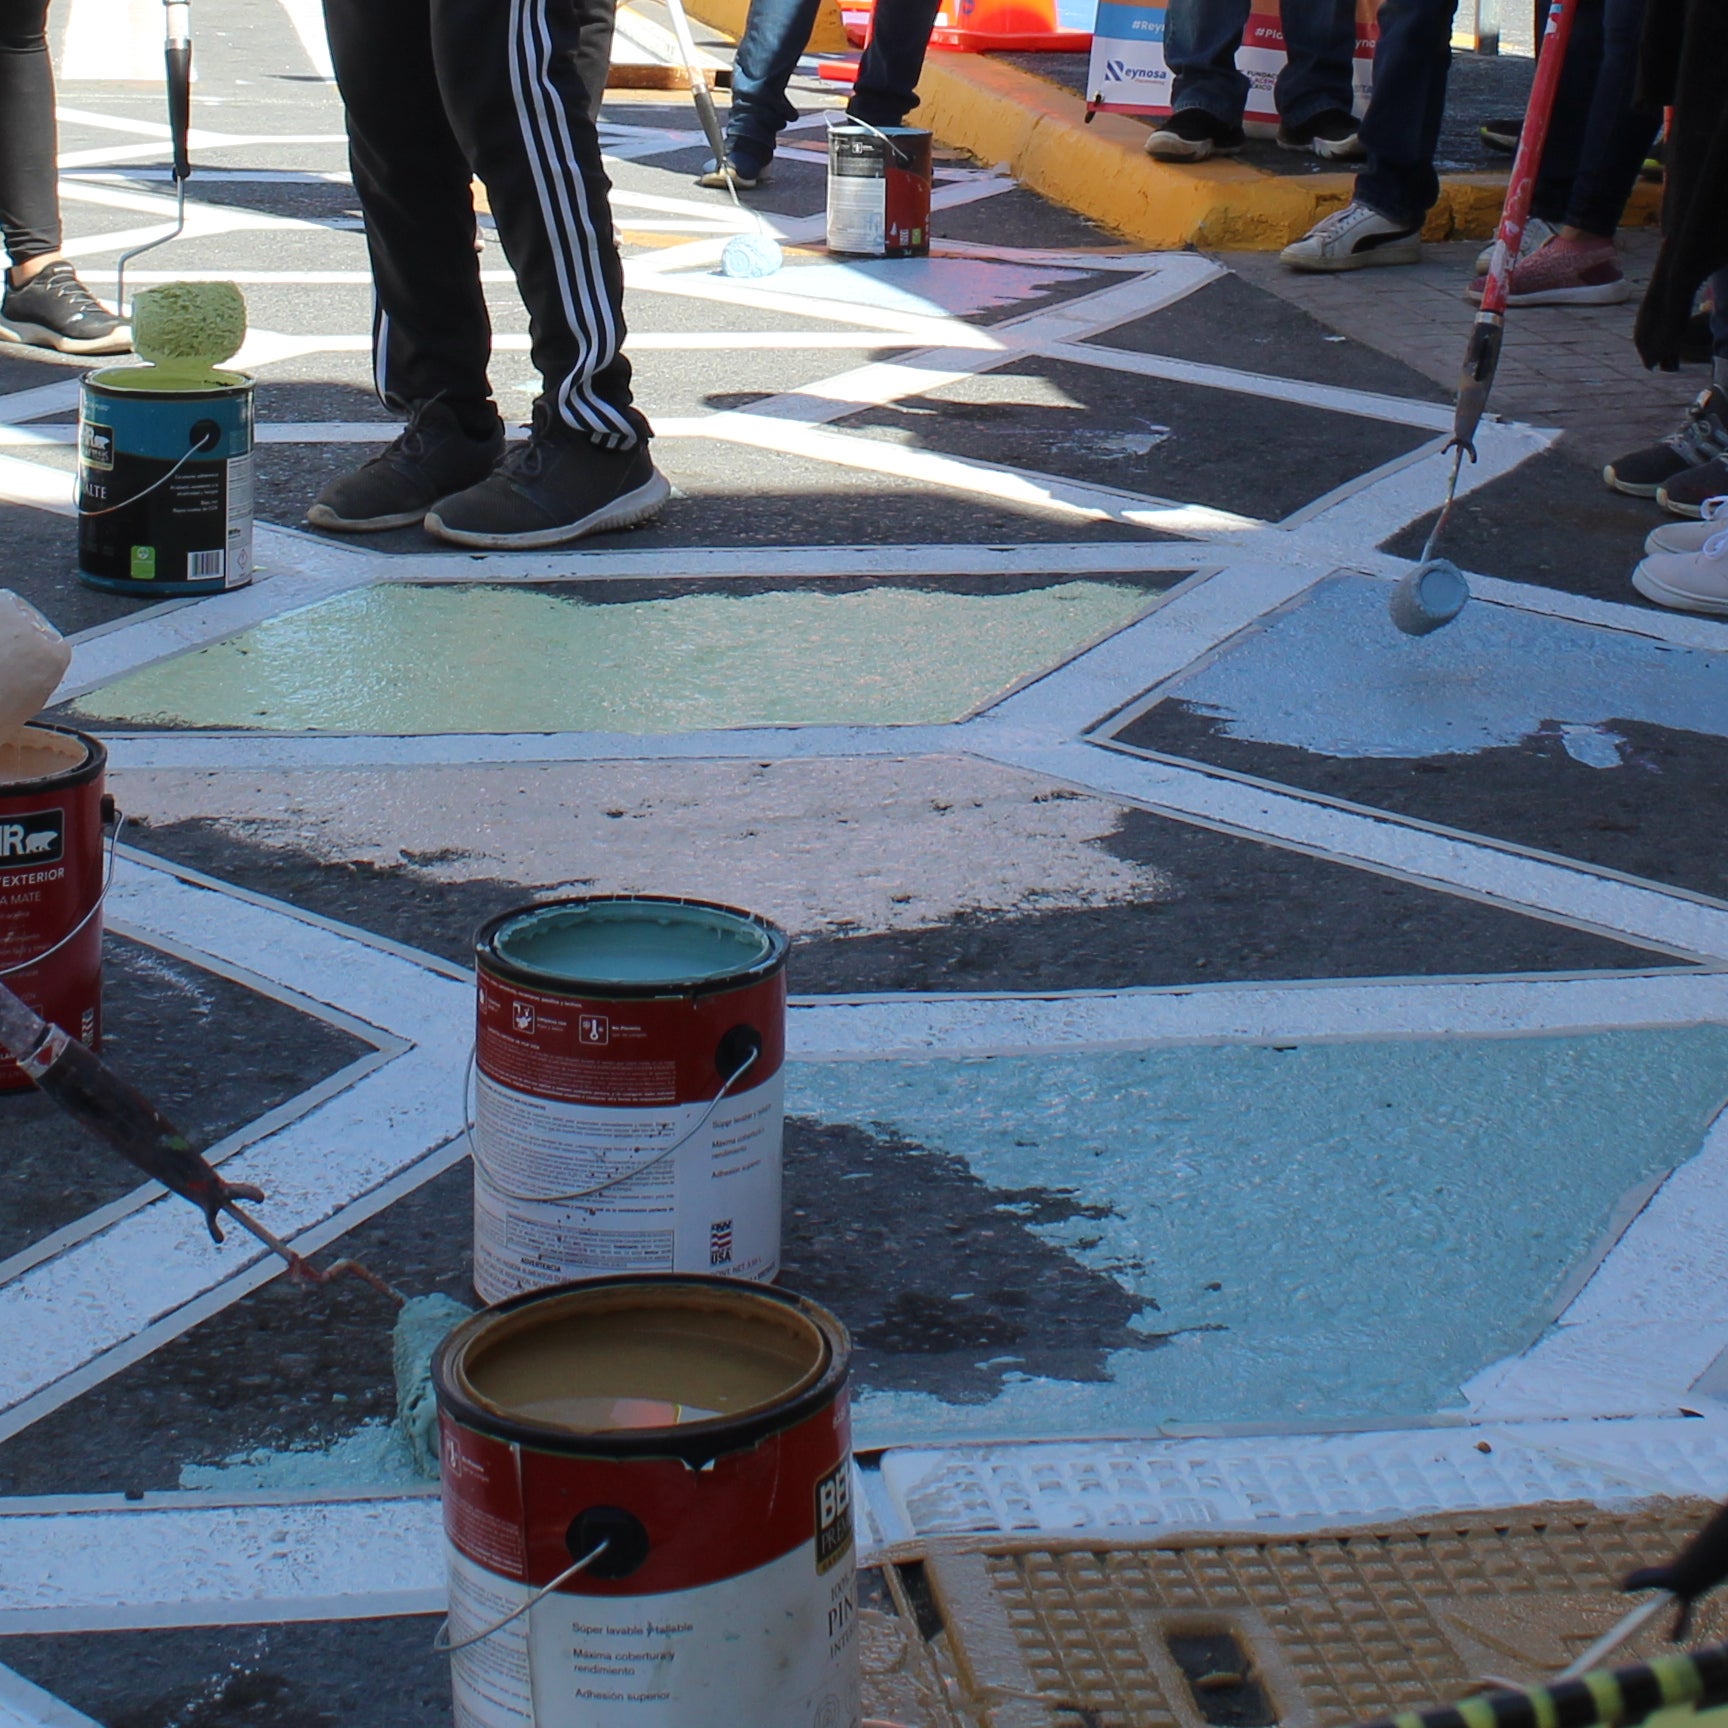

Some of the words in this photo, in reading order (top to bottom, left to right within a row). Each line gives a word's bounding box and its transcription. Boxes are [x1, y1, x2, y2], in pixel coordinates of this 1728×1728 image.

[1104, 60, 1167, 82] Reynosa
[10, 892, 42, 904] MATE
[711, 1248, 732, 1265] USA
[820, 1460, 850, 1529] BE
